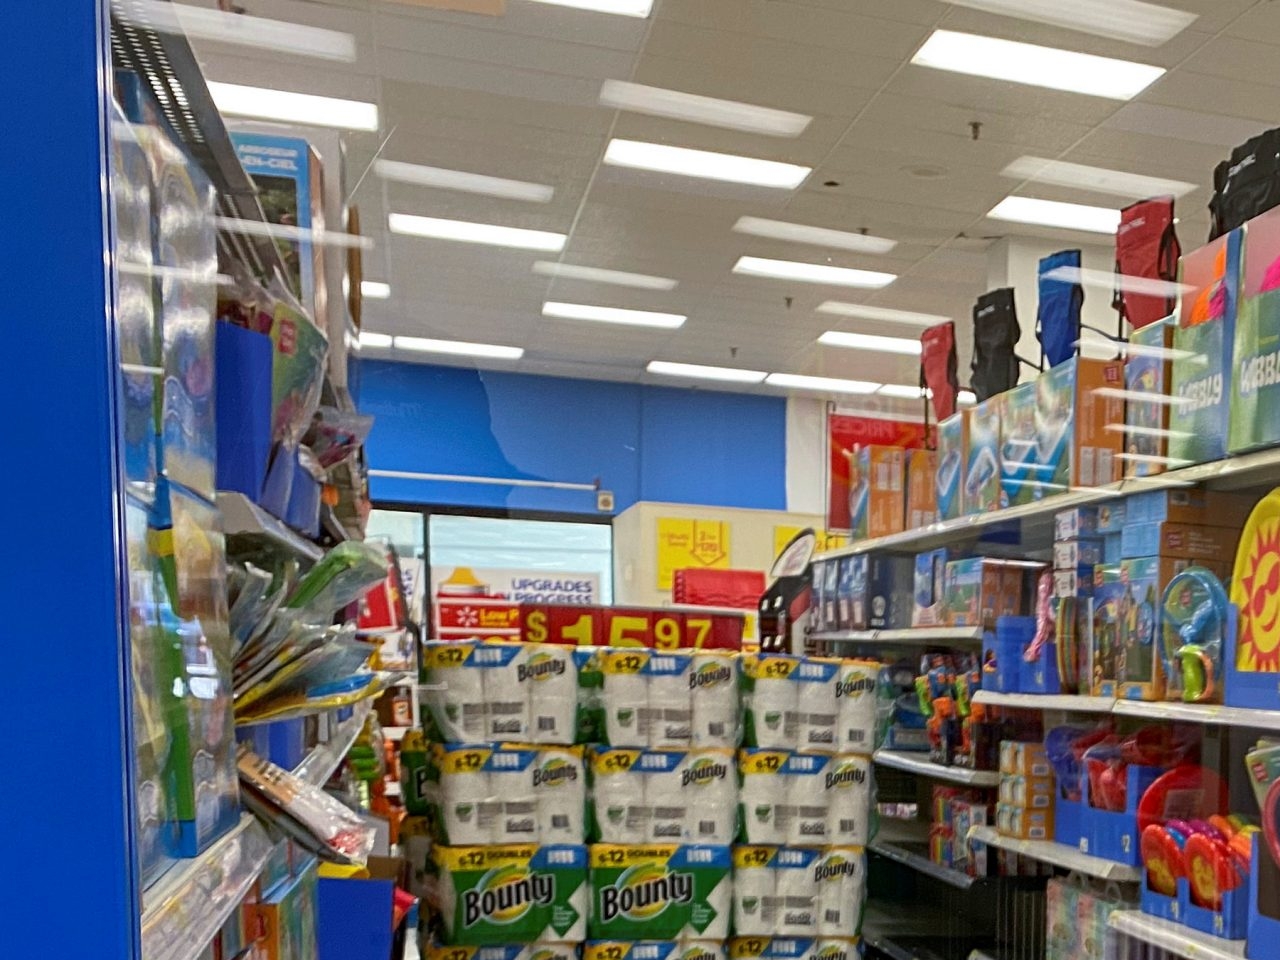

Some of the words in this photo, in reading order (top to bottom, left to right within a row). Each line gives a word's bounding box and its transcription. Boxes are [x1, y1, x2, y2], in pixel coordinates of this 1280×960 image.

[511, 578, 593, 593] UPGRADES
[518, 658, 566, 683] Bounty
[689, 666, 732, 691] Bounty
[835, 674, 876, 699] Bounty
[533, 765, 577, 788] Bounty
[682, 762, 726, 786] Bounty
[826, 766, 866, 789] Bounty
[815, 860, 855, 882] Bounty
[464, 873, 553, 927] Bounty
[602, 873, 693, 923] Bounty
